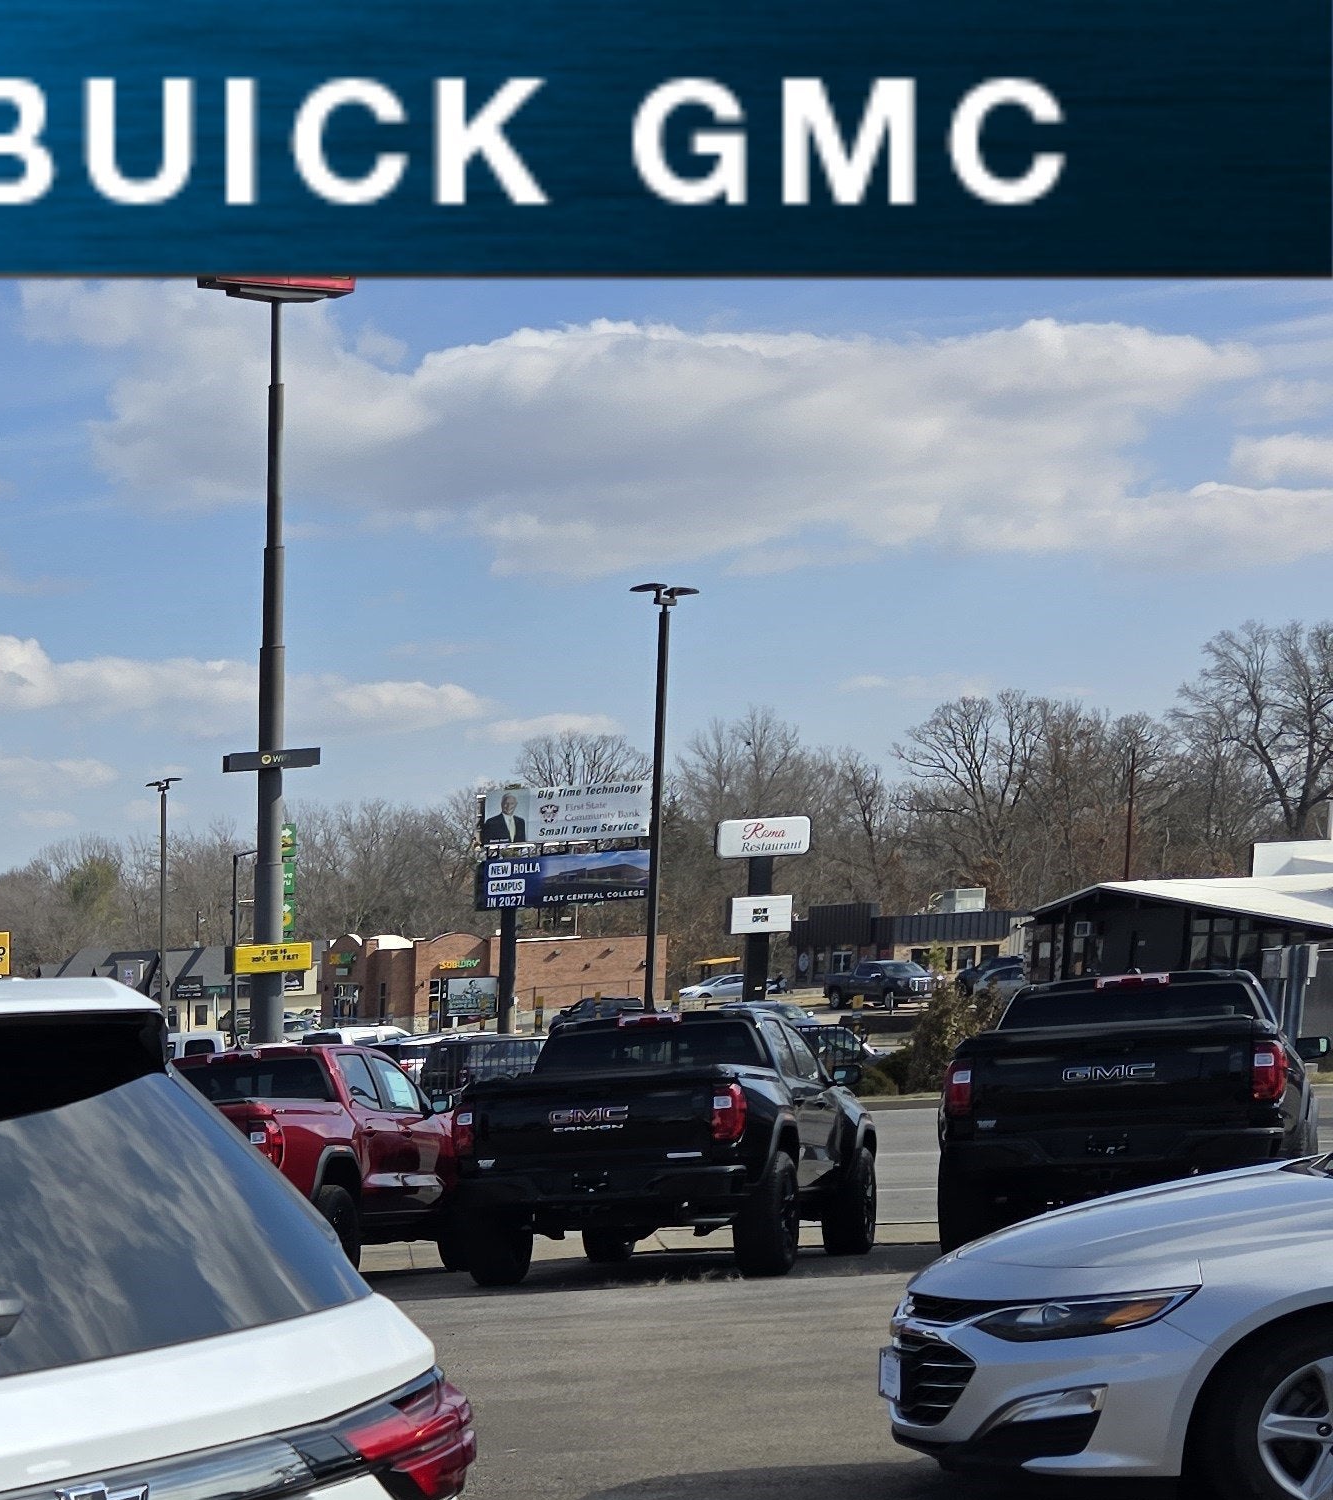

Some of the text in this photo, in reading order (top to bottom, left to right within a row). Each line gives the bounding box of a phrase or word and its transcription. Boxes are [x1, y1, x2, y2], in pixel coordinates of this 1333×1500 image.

[537, 783, 643, 800] Big Time Technology
[565, 801, 608, 812] First State
[564, 809, 640, 823] Community Bank
[538, 825, 568, 837] Small
[571, 823, 597, 834] Town
[600, 821, 639, 832] Service
[741, 840, 802, 853] Restaurant
[490, 862, 541, 876] NEW ROLLA
[490, 880, 523, 894] CAMPUS
[486, 897, 497, 908] IN
[542, 889, 645, 903] EAST CENTRAL COLLEGE
[751, 915, 769, 923] OPEN
[438, 958, 481, 970] SUBWAY
[1062, 1062, 1156, 1082] GMC
[548, 1105, 629, 1125] GMC
